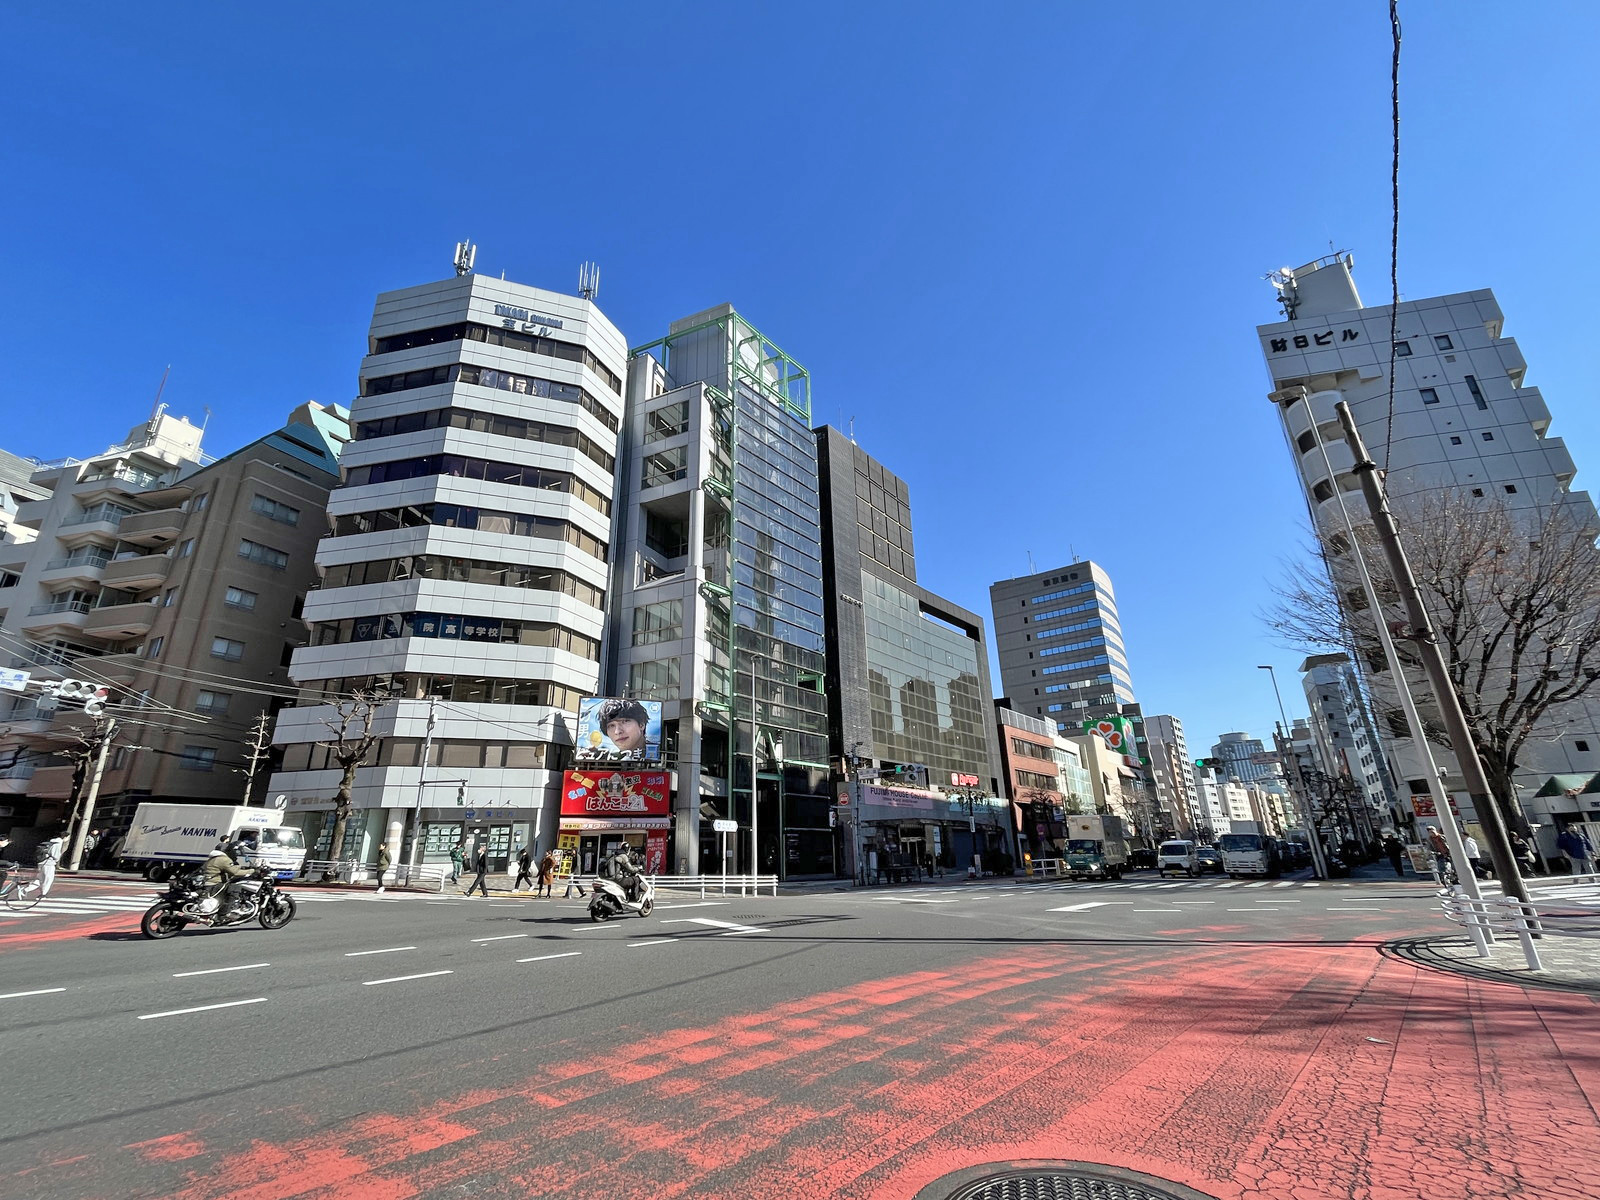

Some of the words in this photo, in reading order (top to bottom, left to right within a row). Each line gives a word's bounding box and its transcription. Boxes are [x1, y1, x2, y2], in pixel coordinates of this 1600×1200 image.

[494, 304, 528, 322] TAKARA
[530, 314, 563, 329] BUILDING
[502, 318, 553, 337] 宝ビル
[1270, 329, 1359, 353] 財日ビル
[181, 828, 218, 838] NANIWA
